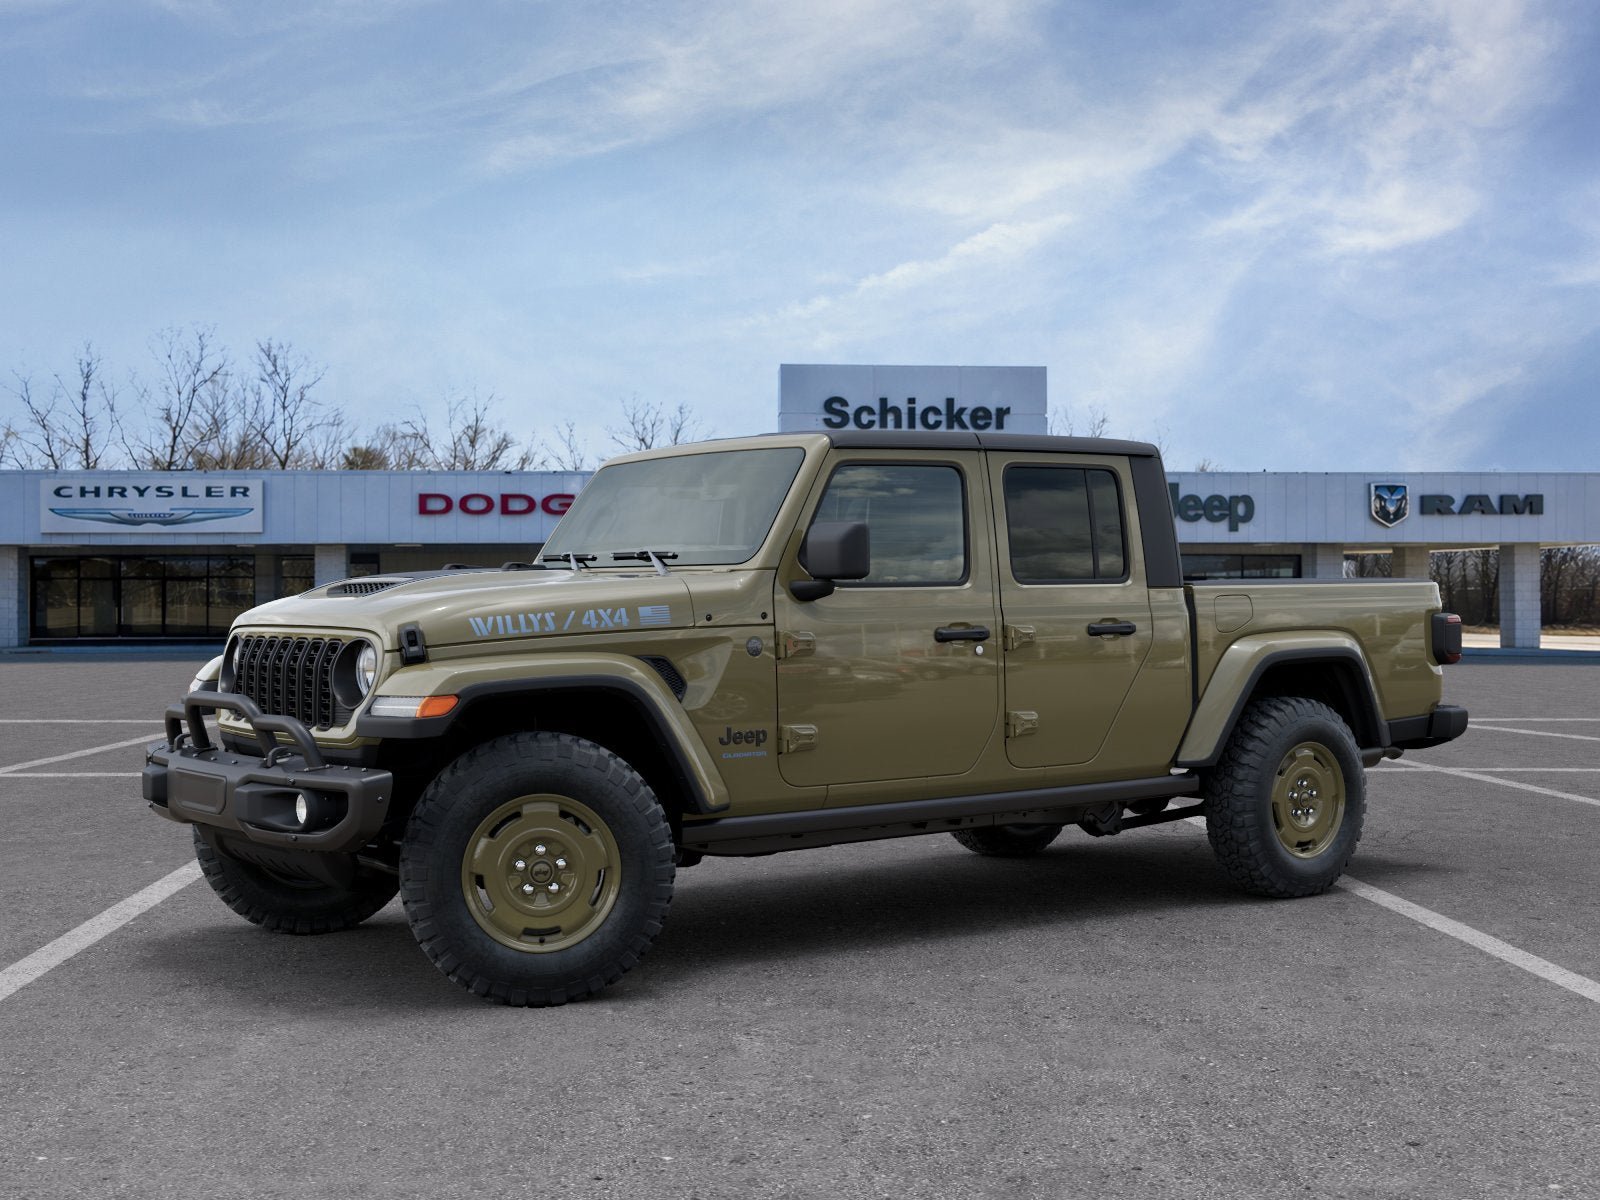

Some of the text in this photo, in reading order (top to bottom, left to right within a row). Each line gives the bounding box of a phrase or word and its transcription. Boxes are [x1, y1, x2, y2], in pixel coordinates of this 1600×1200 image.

[823, 396, 1011, 430] Schicker
[53, 486, 250, 498] CHRYSLER
[1420, 495, 1543, 515] RAM
[468, 612, 555, 637] WILLYS
[582, 607, 629, 629] 4X4
[719, 726, 768, 747] Jeep
